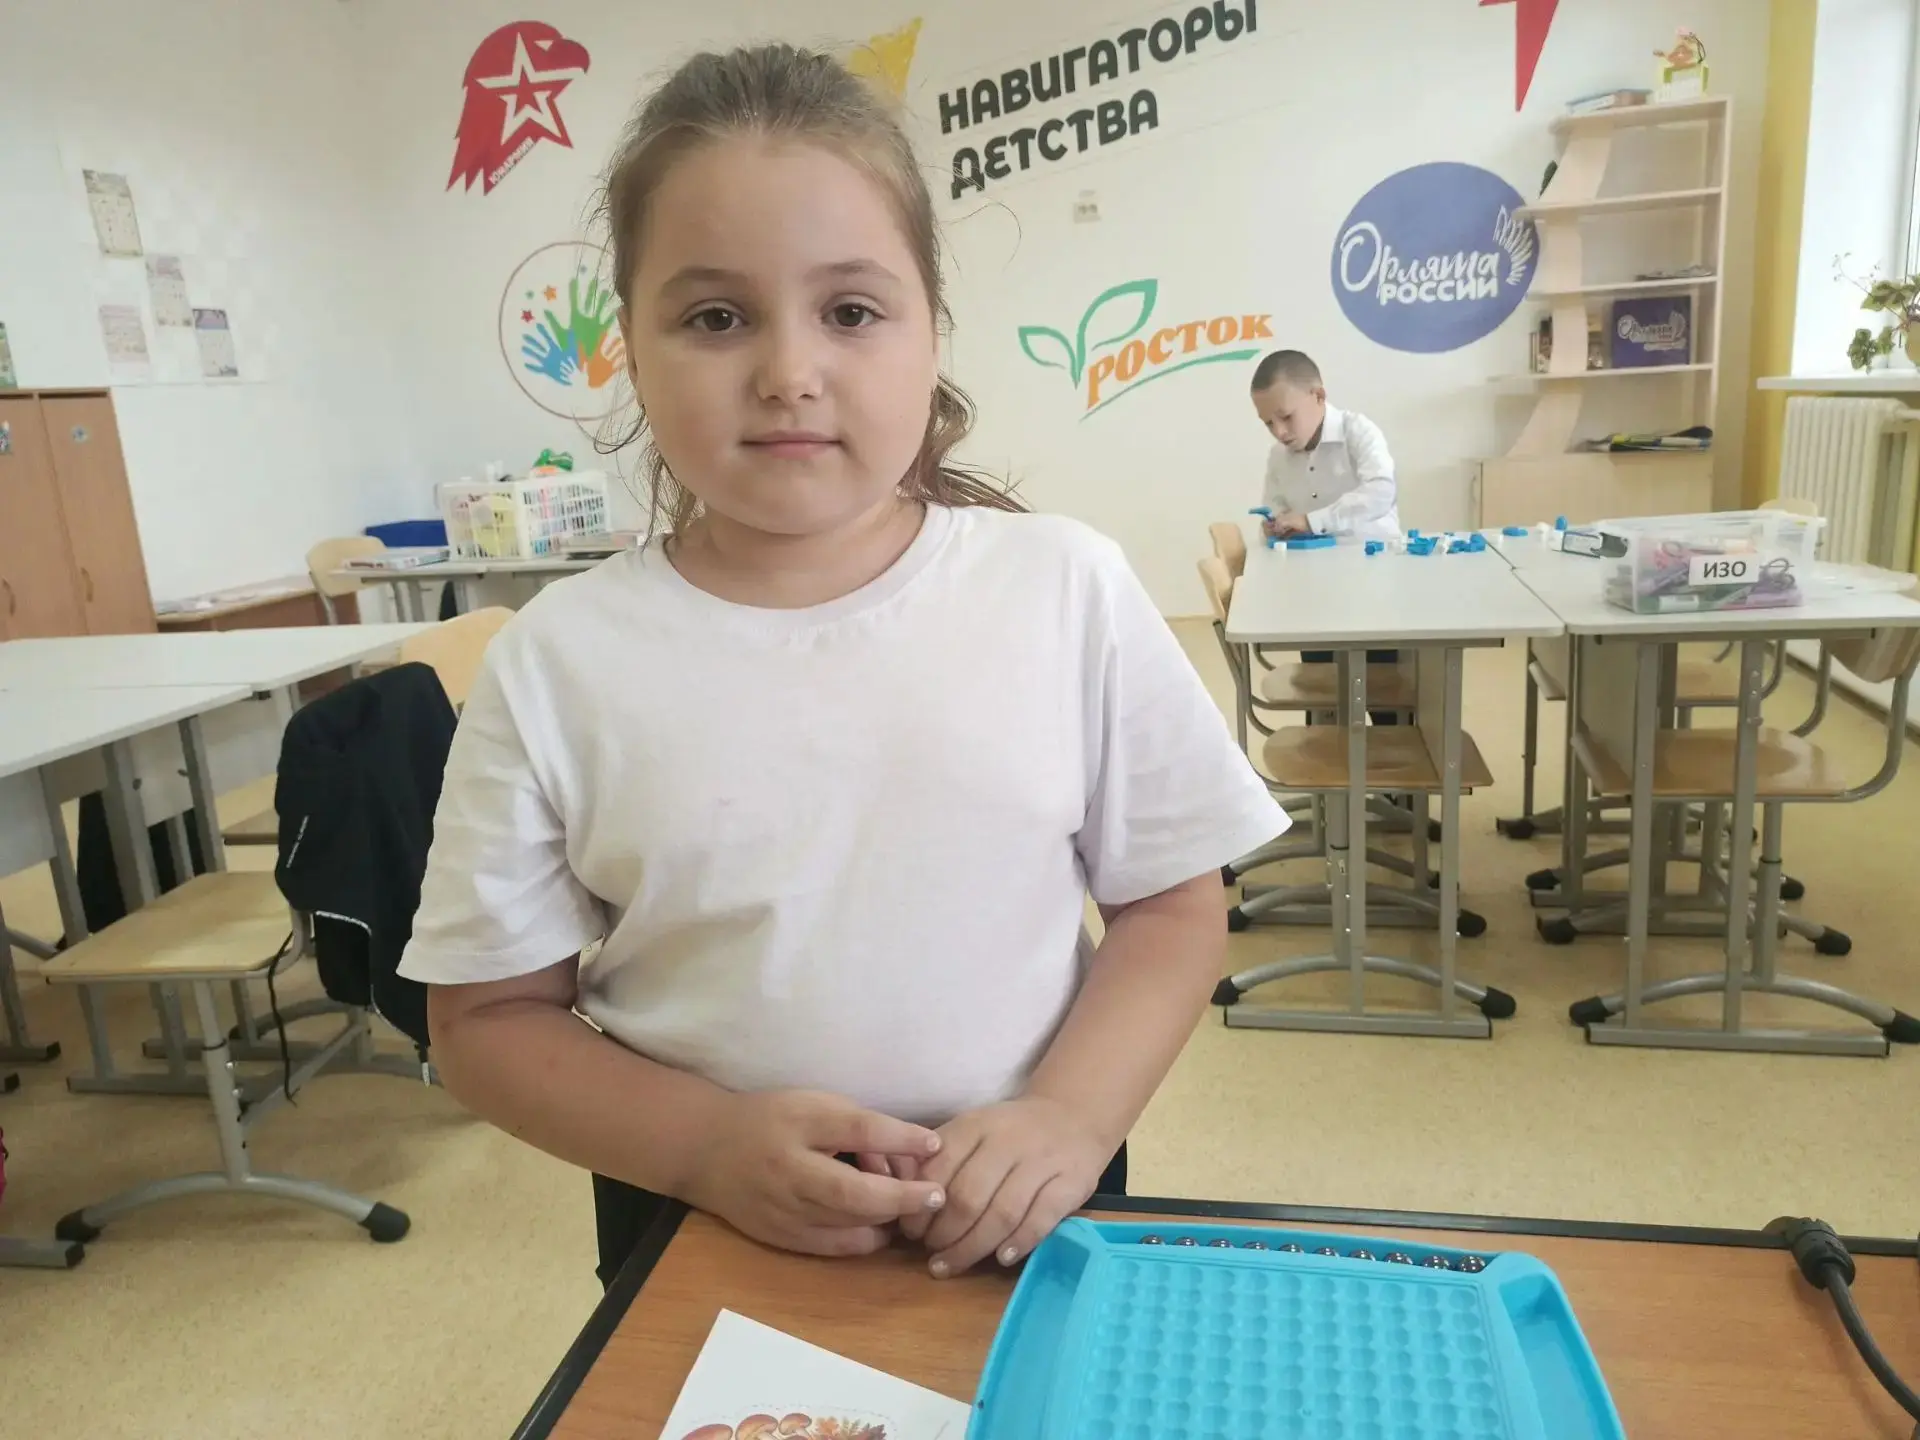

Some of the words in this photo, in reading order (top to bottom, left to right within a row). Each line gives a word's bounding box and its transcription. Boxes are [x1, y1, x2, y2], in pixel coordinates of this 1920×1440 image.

[938, 0, 1257, 134] НАВИГАТОРЫ
[951, 89, 1159, 199] ДЕТСТВА
[1340, 221, 1500, 298] Орлята
[1379, 276, 1499, 306] РОССИИ
[1086, 314, 1274, 410] РОСТОК
[1703, 560, 1747, 578] ИЗО
